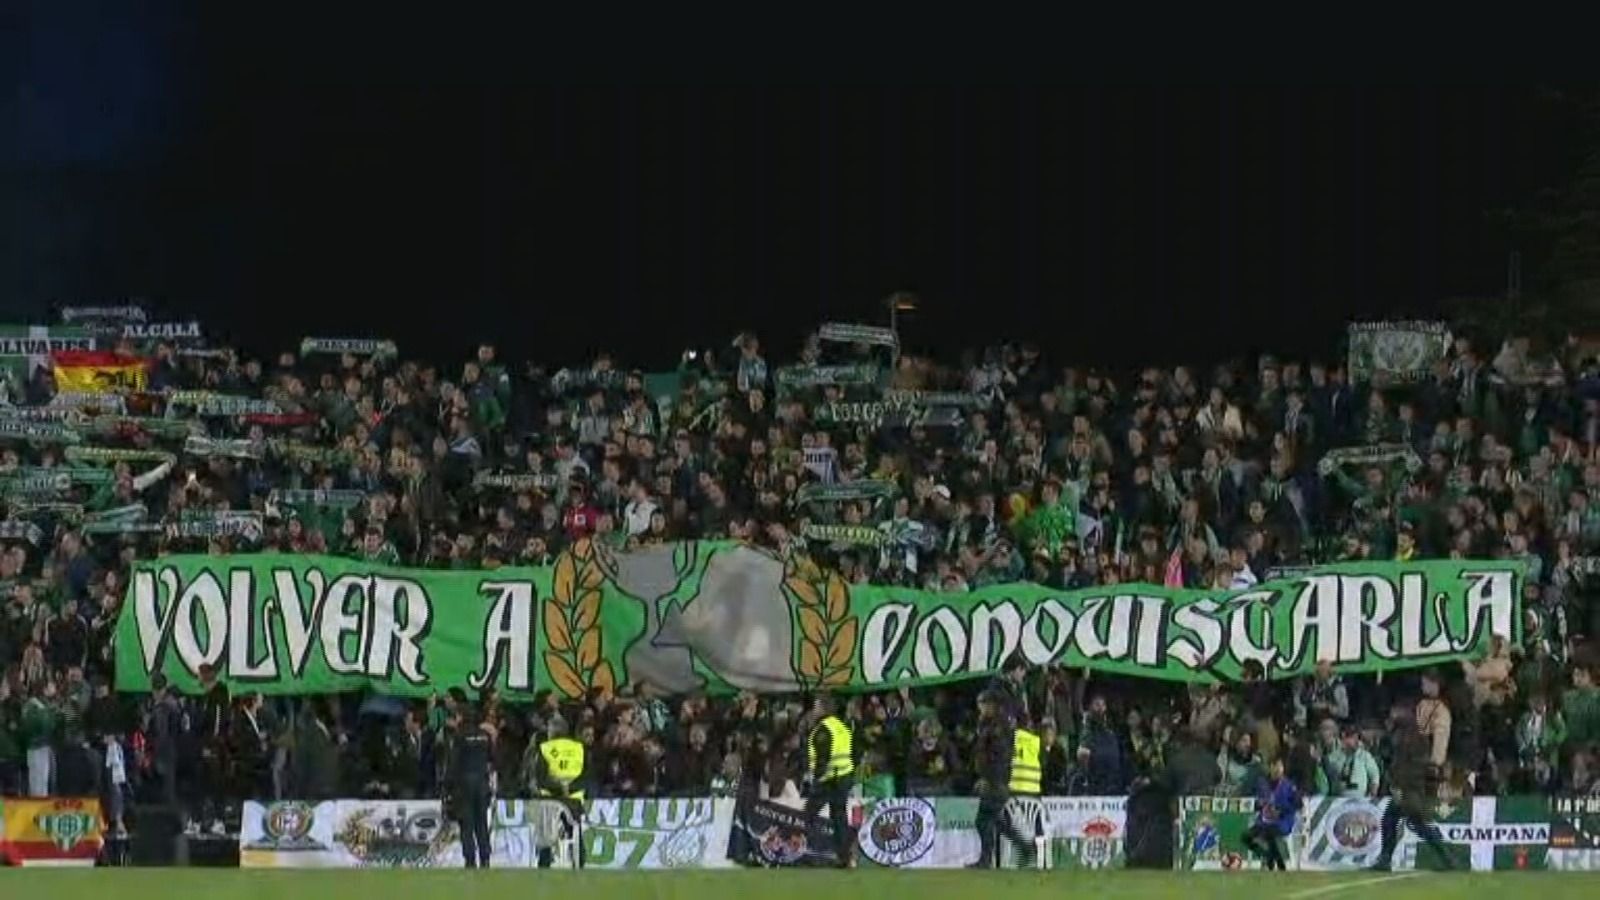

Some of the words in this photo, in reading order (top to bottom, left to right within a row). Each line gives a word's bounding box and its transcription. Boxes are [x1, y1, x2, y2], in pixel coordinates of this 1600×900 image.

[0, 339, 93, 357] LIVARES
[134, 566, 433, 684] VOLVER
[468, 579, 537, 694] A
[1448, 828, 1548, 840] CAMPANA
